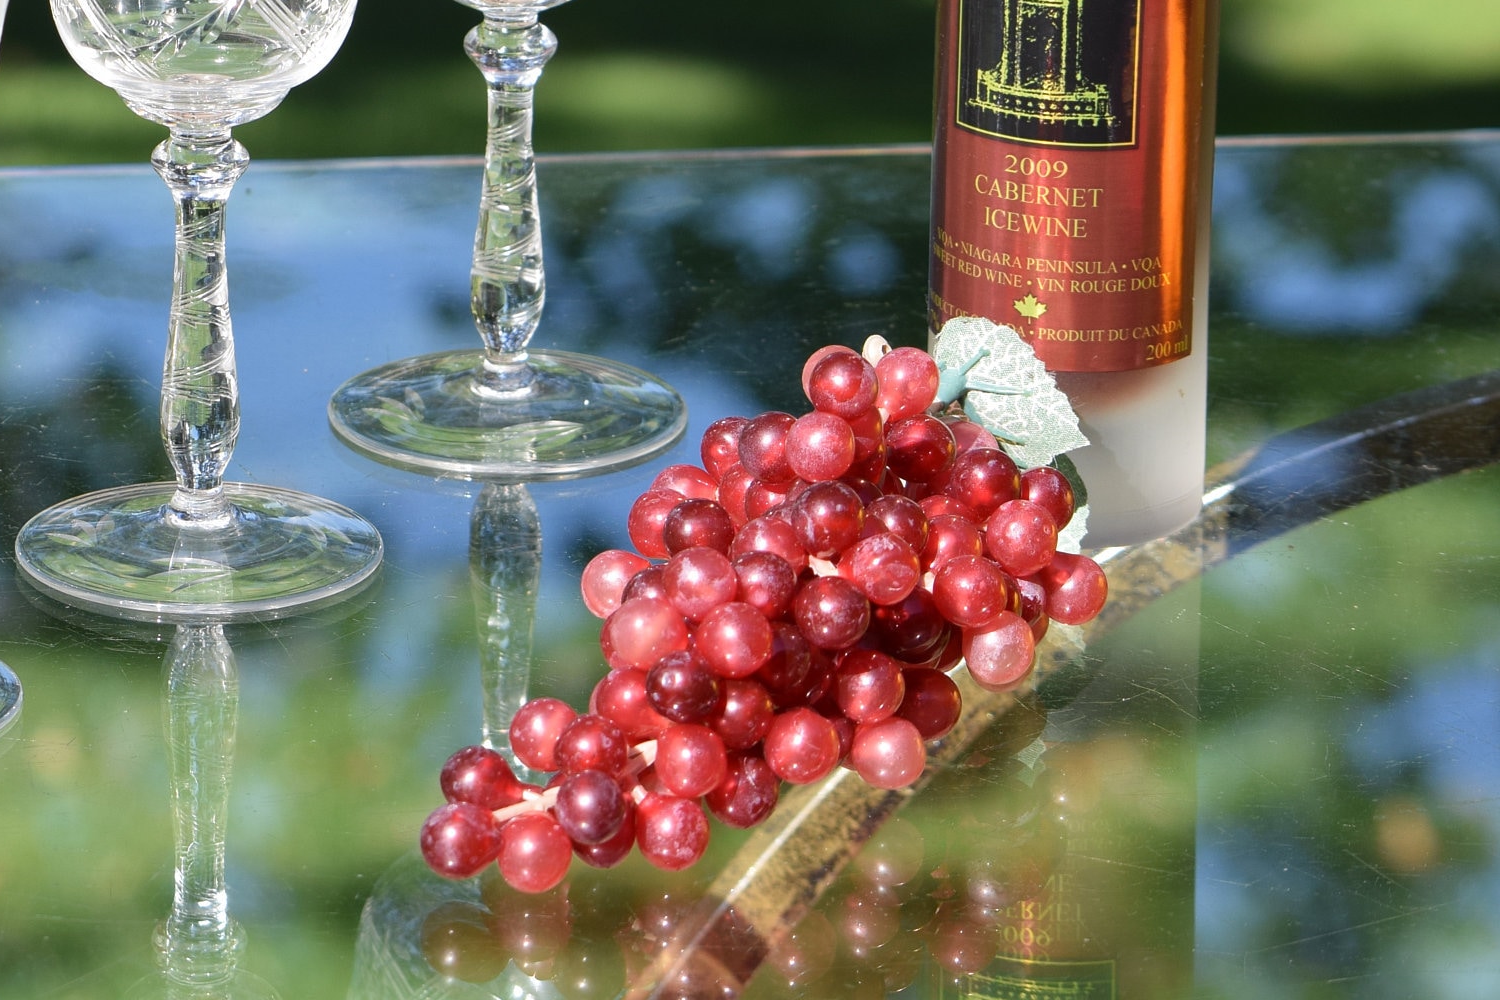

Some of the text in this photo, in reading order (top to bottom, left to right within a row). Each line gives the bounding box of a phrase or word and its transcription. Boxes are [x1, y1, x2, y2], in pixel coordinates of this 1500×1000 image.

[1004, 155, 1068, 179] 2009
[975, 174, 1104, 208] CABERNET
[984, 207, 1088, 239] ICEWINE
[961, 241, 1022, 269] NIAGARA
[1026, 257, 1118, 275] PENINSULA
[1132, 256, 1162, 272] VQA
[958, 259, 982, 278] RED
[984, 268, 1022, 288] WINE
[1036, 277, 1065, 292] VIN
[1070, 280, 1126, 293] ROUGE
[1131, 272, 1171, 291] DOUX
[1038, 328, 1105, 342] PRODUIT
[1108, 328, 1129, 341] DU
[1132, 320, 1183, 339] CANADA
[1146, 341, 1171, 360] 200
